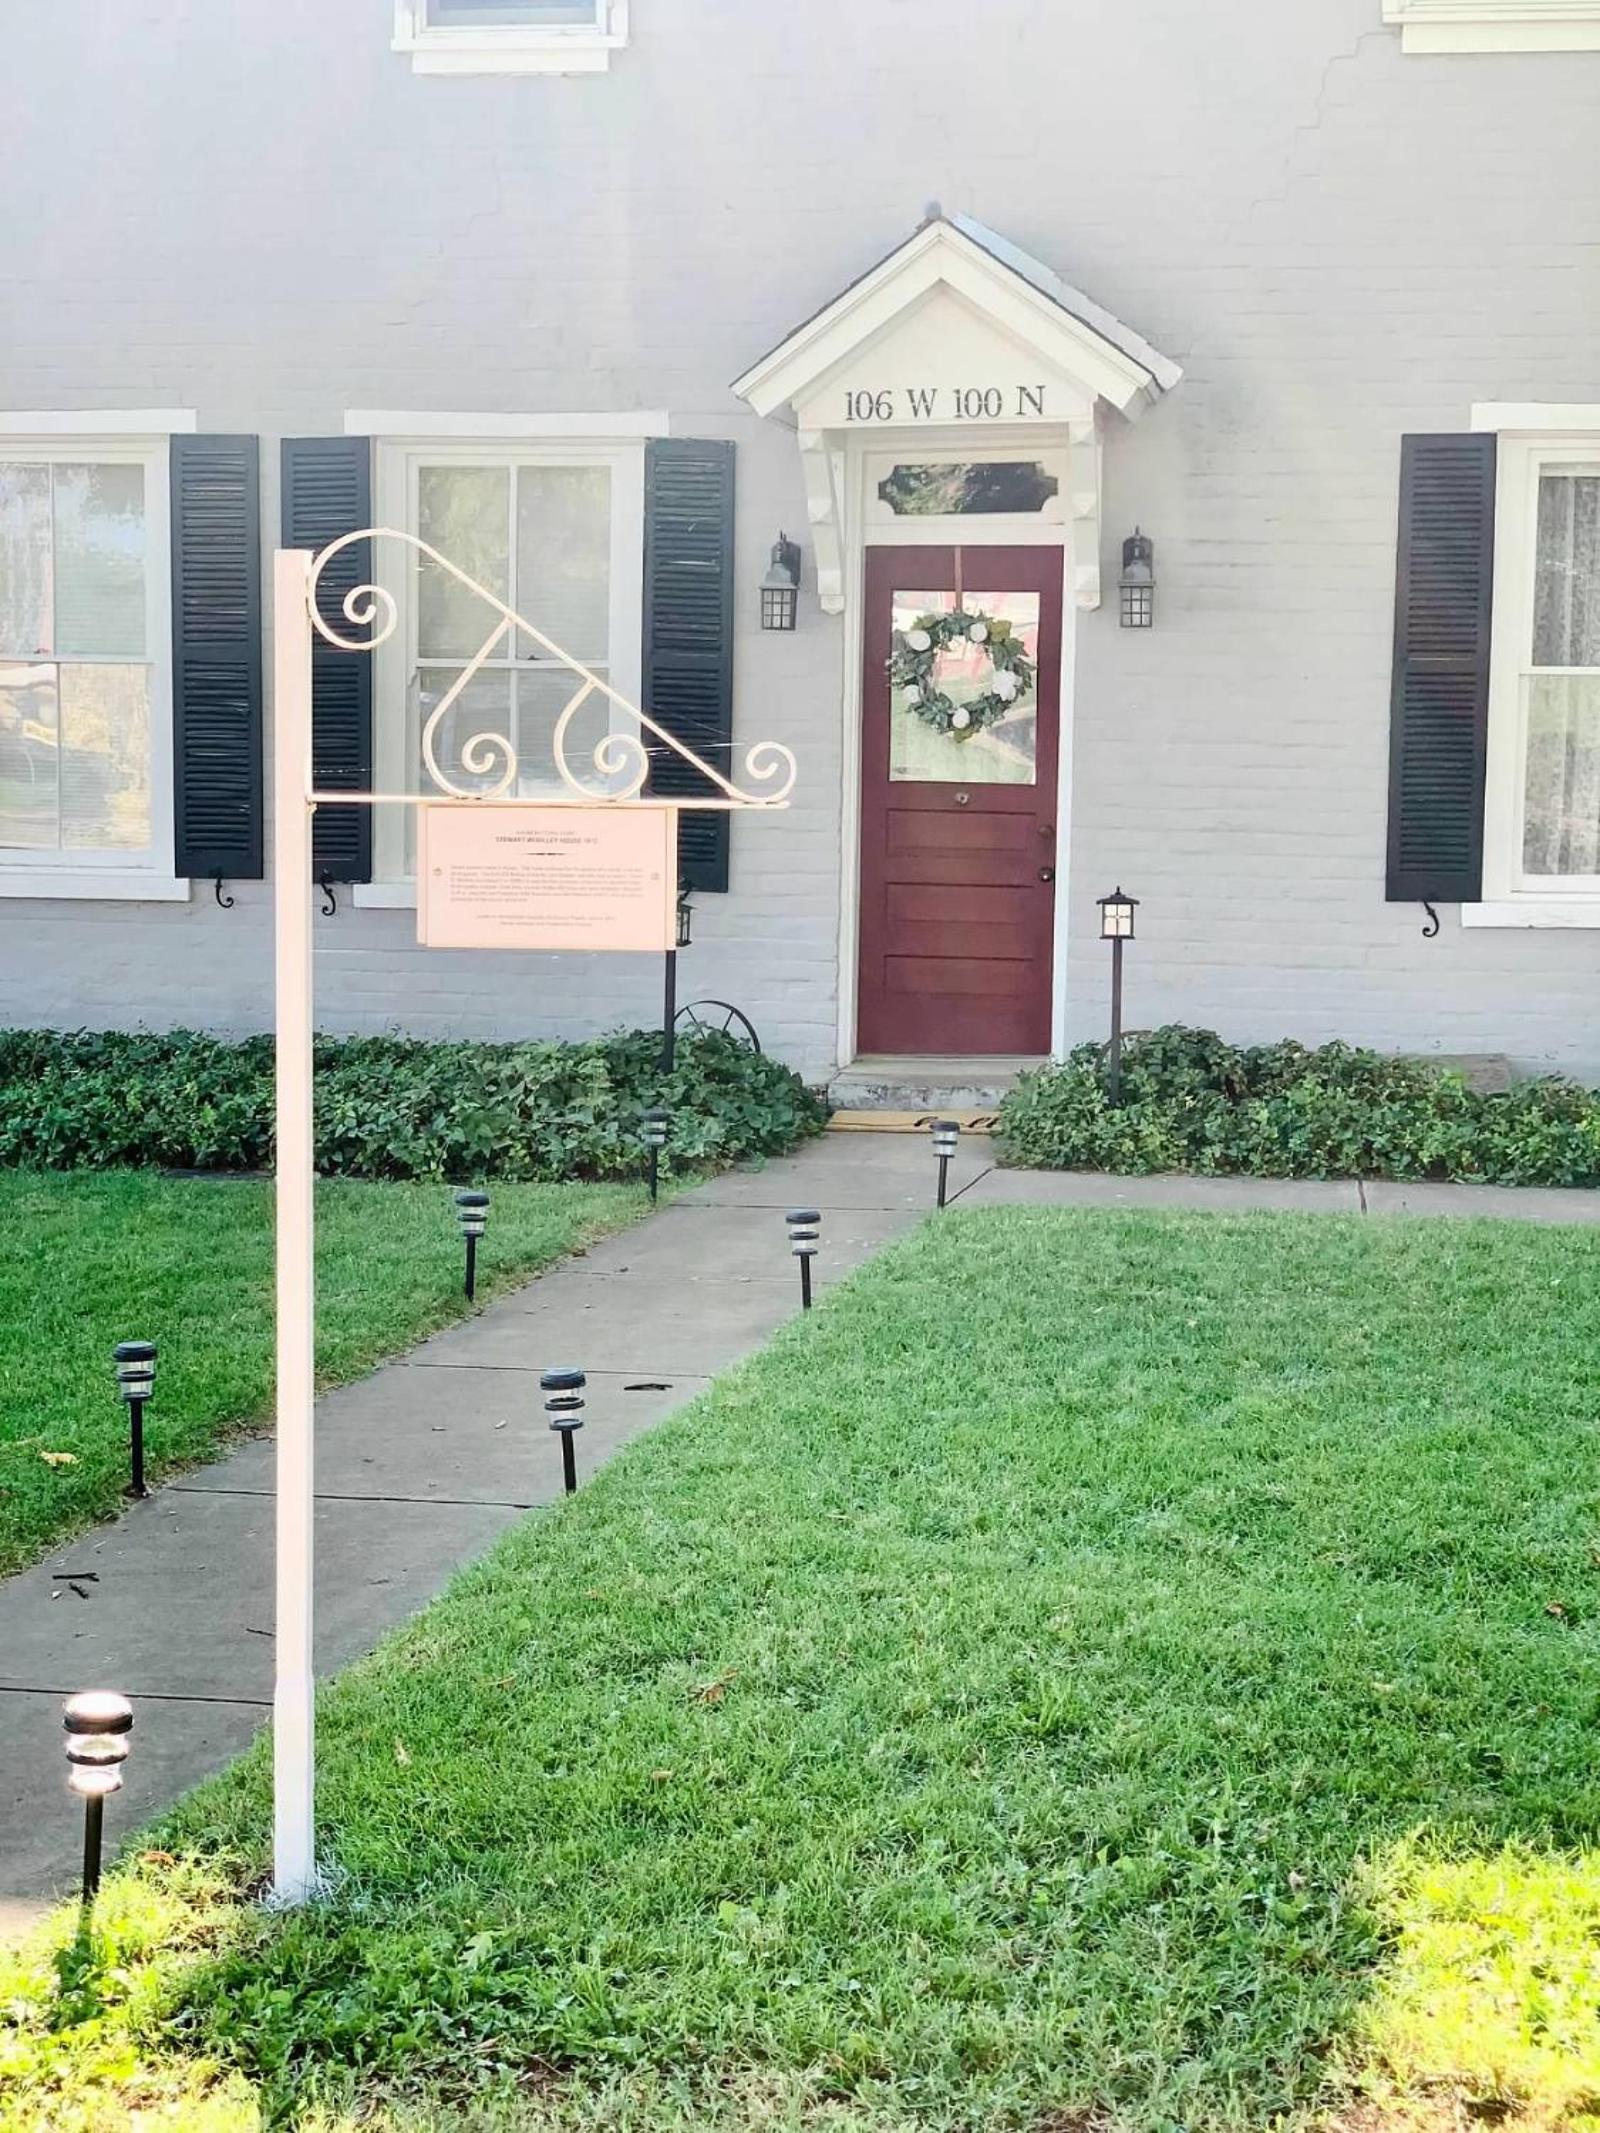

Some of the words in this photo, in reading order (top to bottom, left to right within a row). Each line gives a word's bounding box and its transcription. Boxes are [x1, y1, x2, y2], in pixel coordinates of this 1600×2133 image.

[845, 390, 893, 421] 106
[906, 388, 938, 418] W
[952, 387, 1002, 419] 100
[1015, 385, 1046, 416] N
